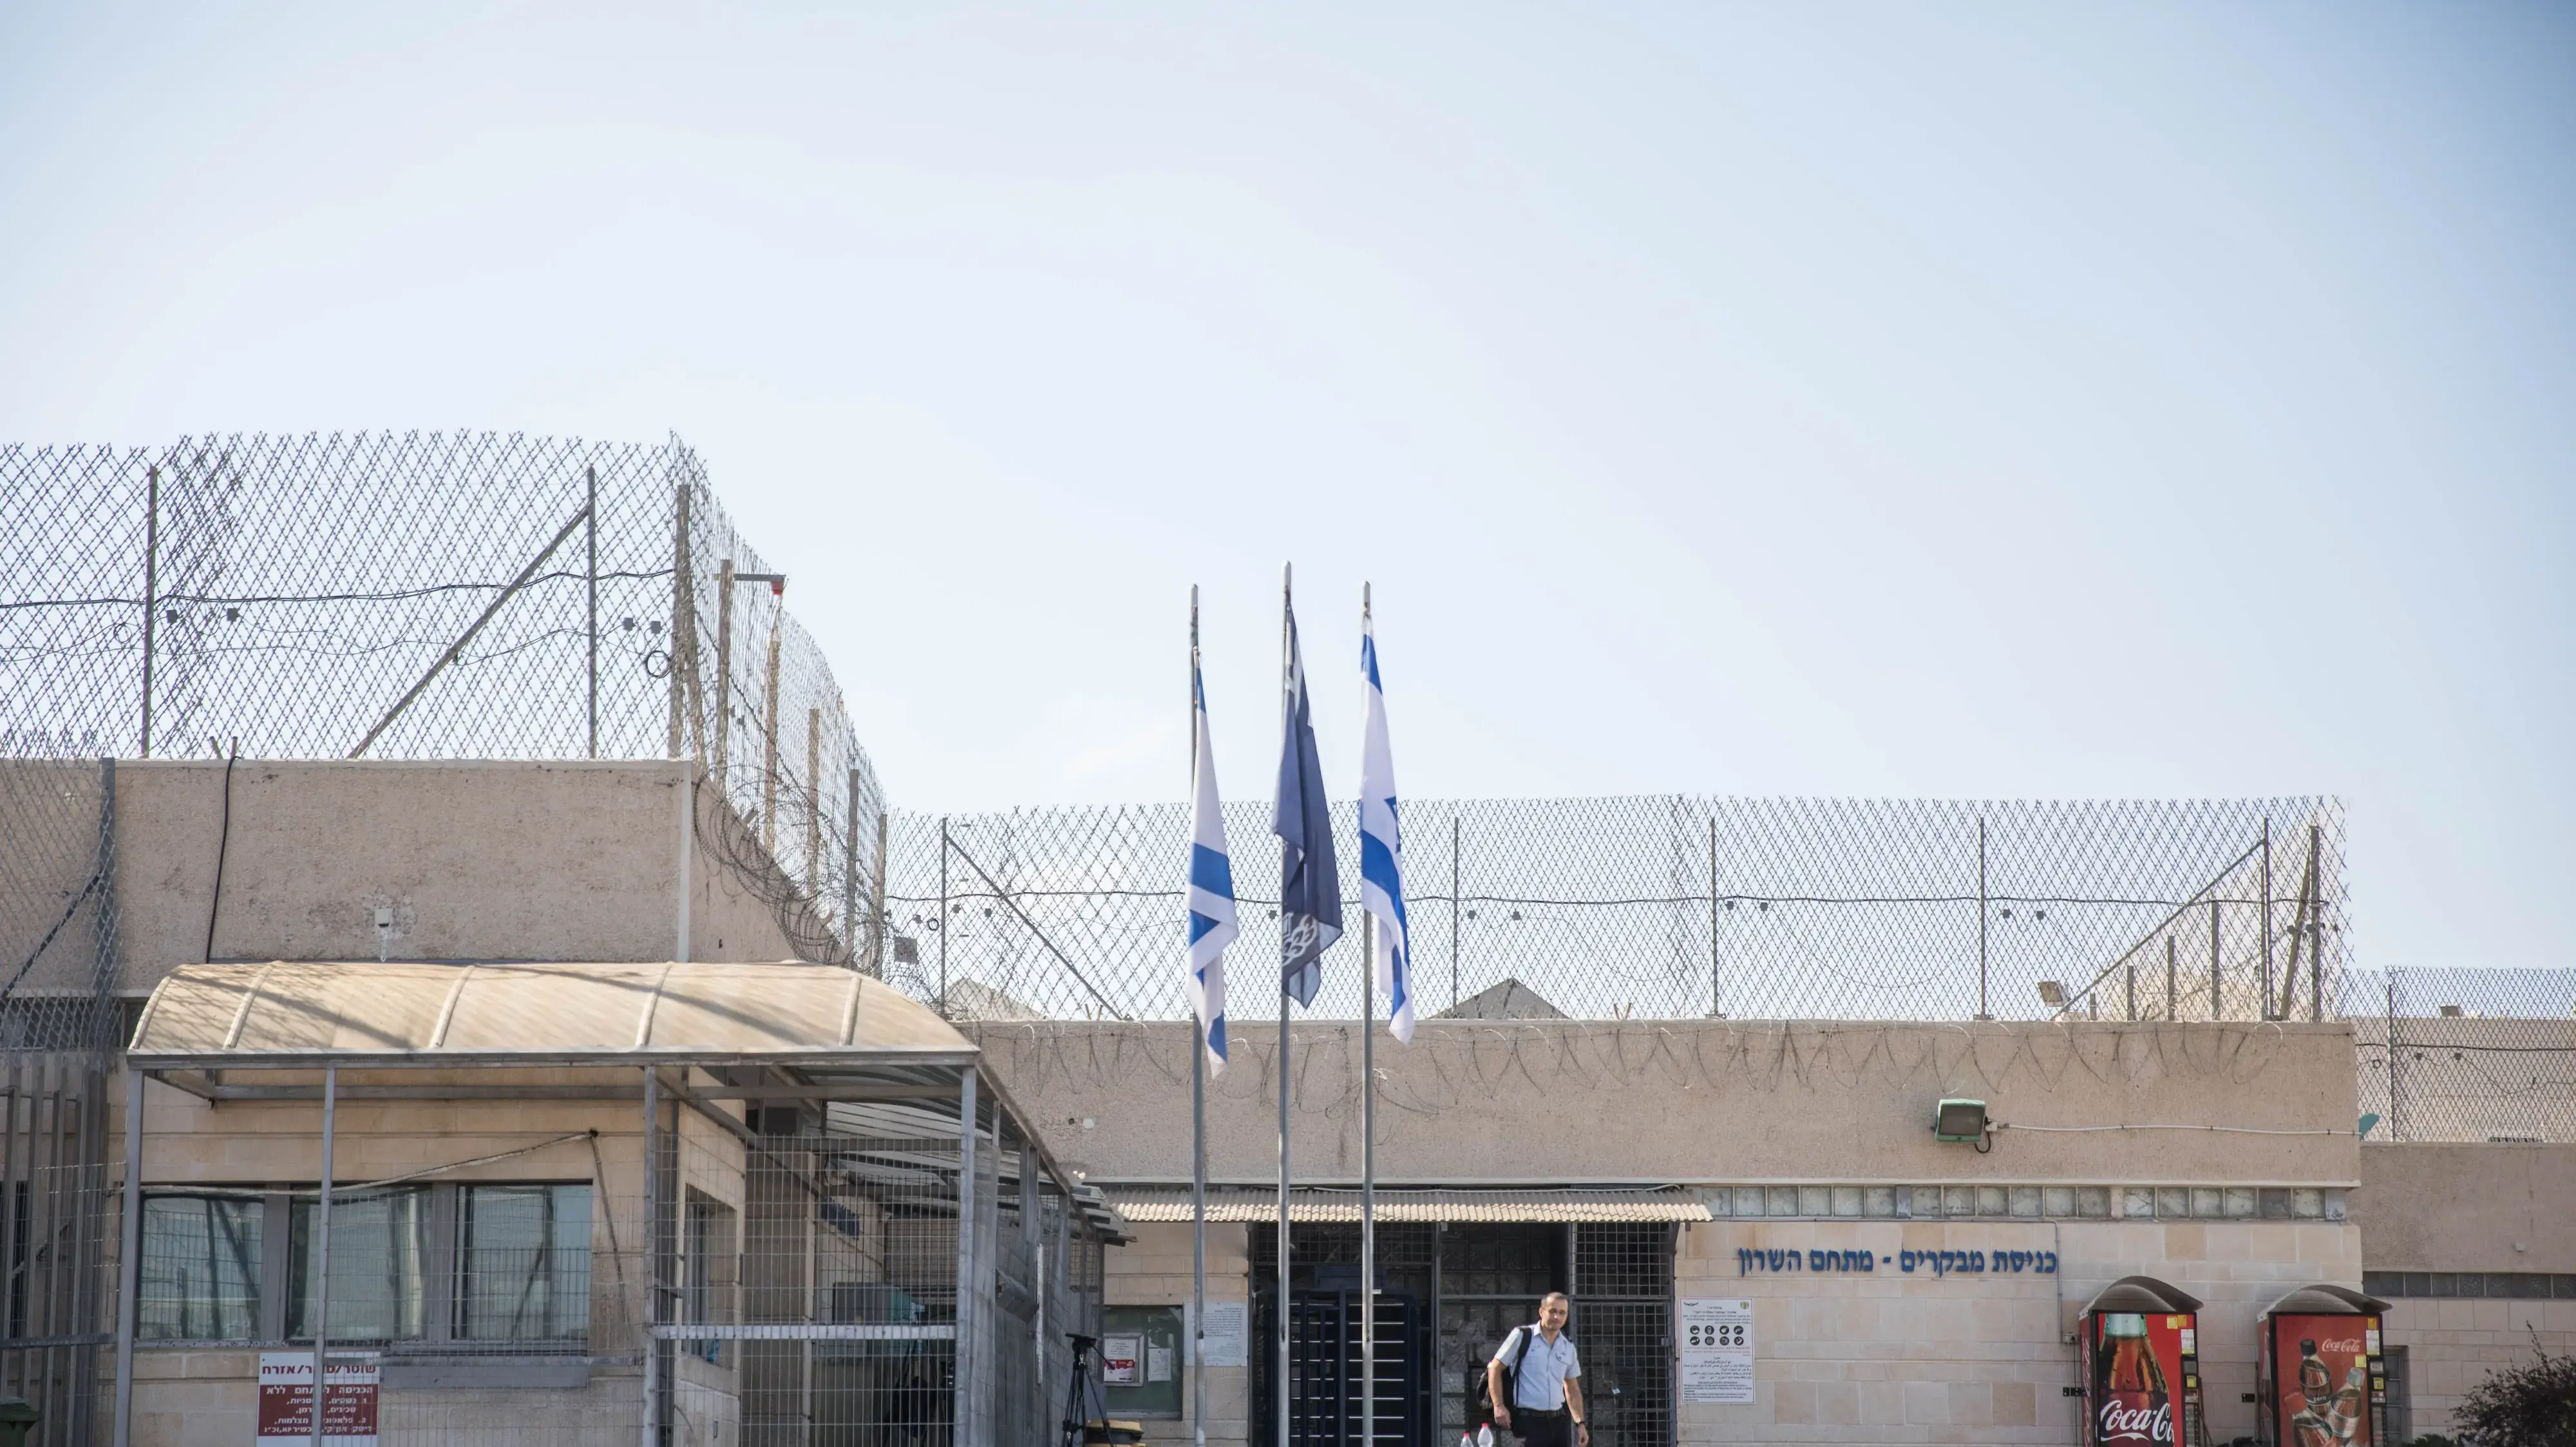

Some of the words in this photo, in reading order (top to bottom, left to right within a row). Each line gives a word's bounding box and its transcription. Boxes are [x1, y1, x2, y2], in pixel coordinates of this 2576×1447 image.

[1738, 1247, 1801, 1278] השרון
[1809, 1248, 1873, 1272] מתחם
[1900, 1249, 1985, 1278] מבקרים
[1993, 1249, 2057, 1273] כניסת
[266, 1385, 286, 1394] ללא
[274, 1415, 308, 1424] מצלמות,
[2100, 1399, 2175, 1443] Coca-Co
